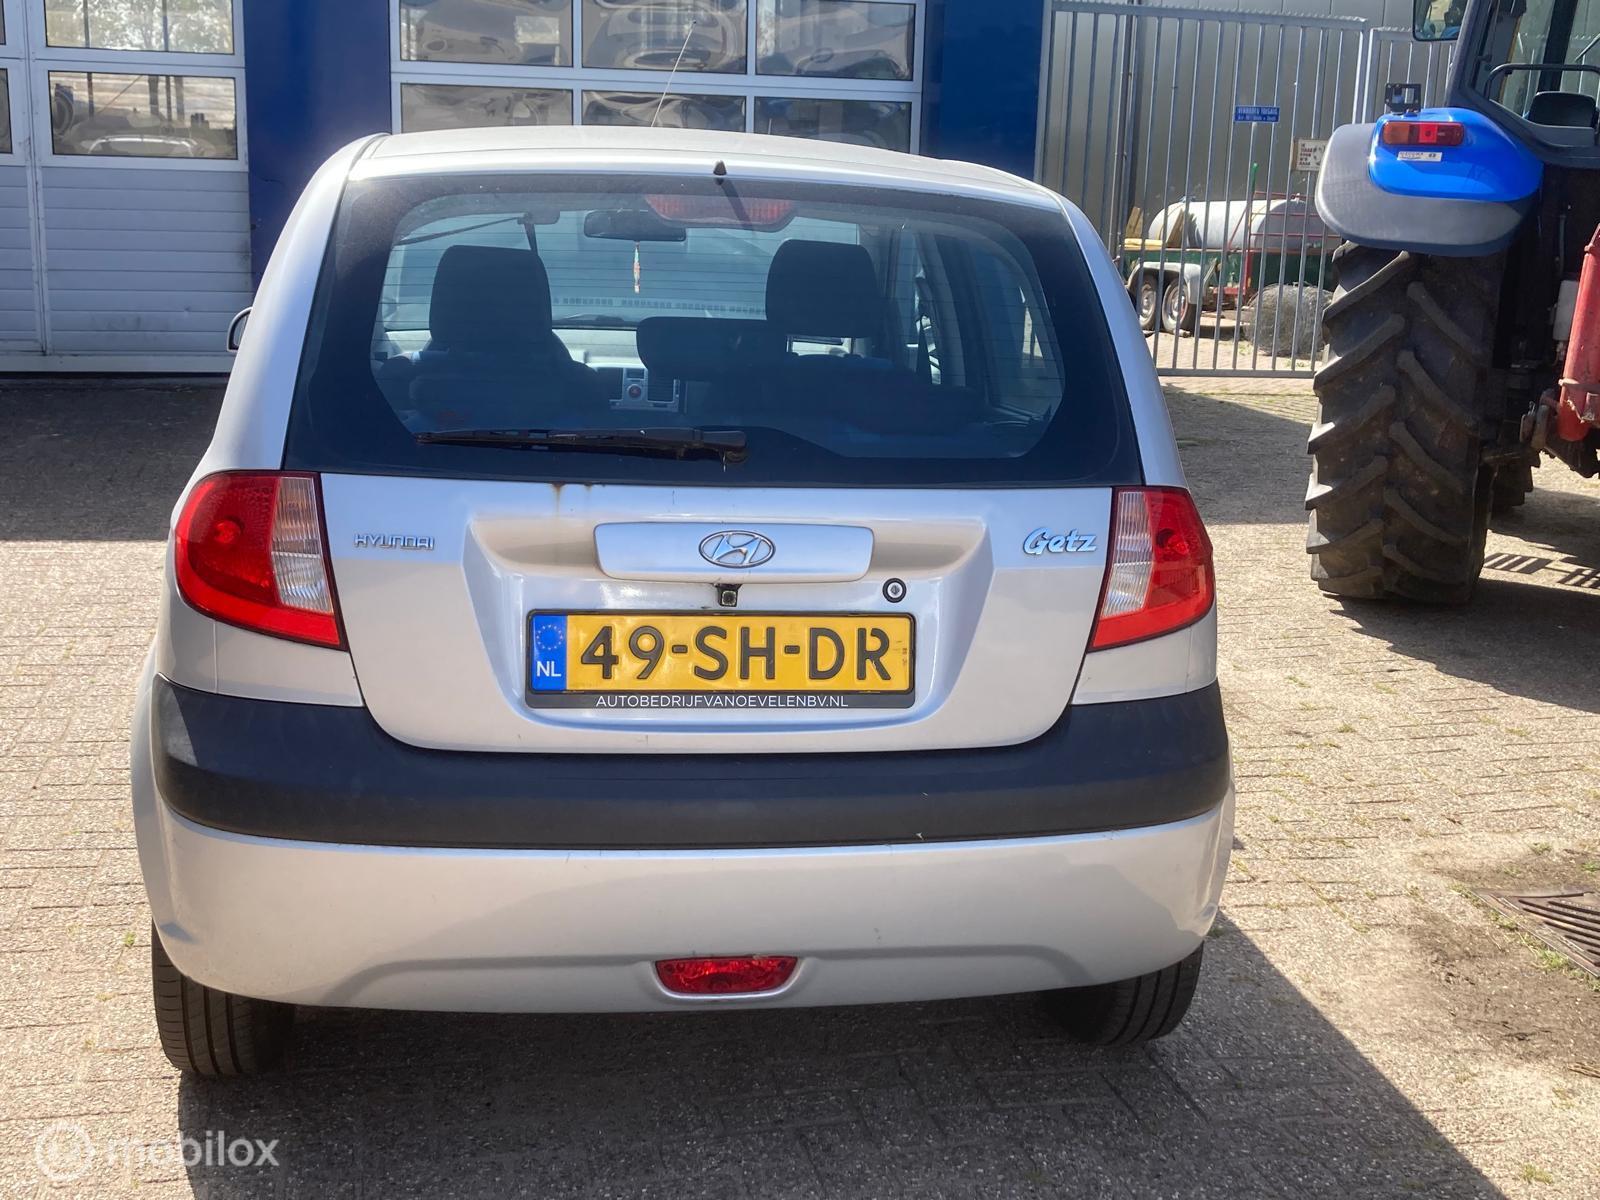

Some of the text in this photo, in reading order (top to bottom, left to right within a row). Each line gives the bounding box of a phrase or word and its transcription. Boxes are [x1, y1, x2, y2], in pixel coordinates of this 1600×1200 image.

[354, 534, 435, 550] HYUNDAI
[1023, 527, 1097, 554] Getz
[580, 626, 892, 680] 49-SH-DR
[536, 661, 562, 677] NL
[595, 695, 848, 708] AUTOBEDRIJFVANOEVELENBV.NL
